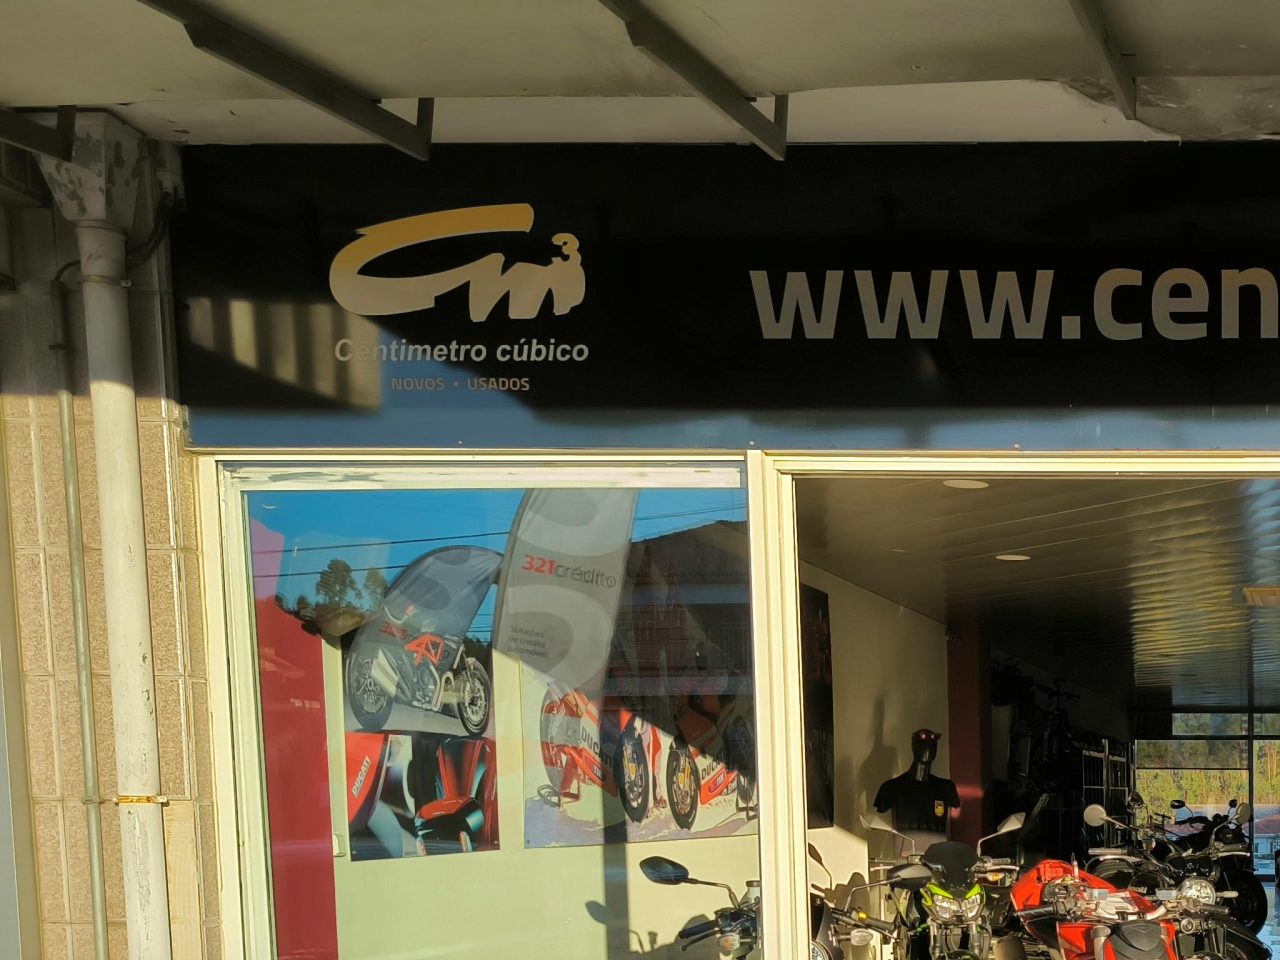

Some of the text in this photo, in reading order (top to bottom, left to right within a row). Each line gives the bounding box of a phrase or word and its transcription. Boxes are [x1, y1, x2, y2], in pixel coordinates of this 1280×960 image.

[334, 338, 590, 362] Centimetro cúbico
[391, 377, 531, 392] NOVOS USADOS
[351, 756, 371, 799] DUCATI
